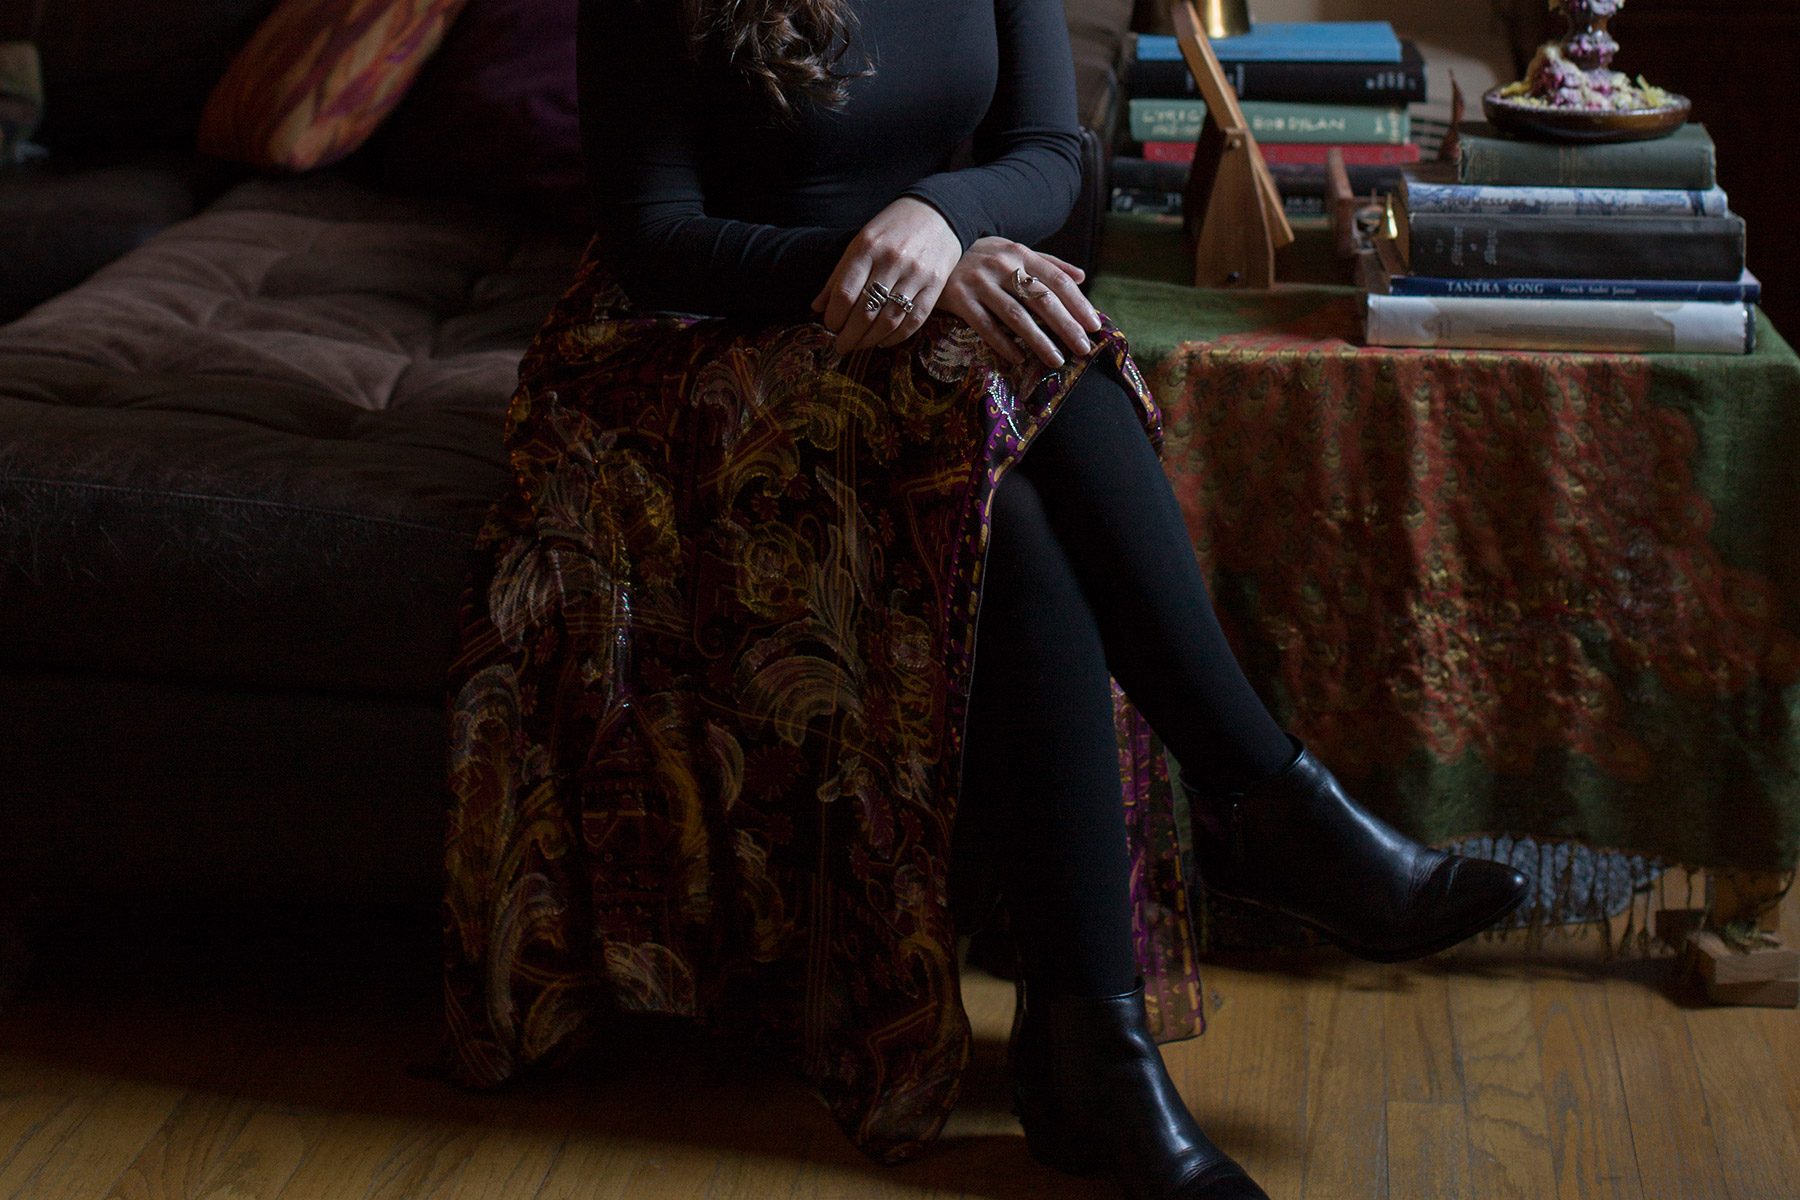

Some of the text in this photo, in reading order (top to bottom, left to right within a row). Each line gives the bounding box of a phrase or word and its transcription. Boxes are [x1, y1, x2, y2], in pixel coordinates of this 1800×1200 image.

[1142, 109, 1201, 123] LYRIC
[1253, 117, 1346, 132] BOB DYLAN
[1447, 280, 1500, 294] TANTRA
[1507, 281, 1545, 294] SONG
